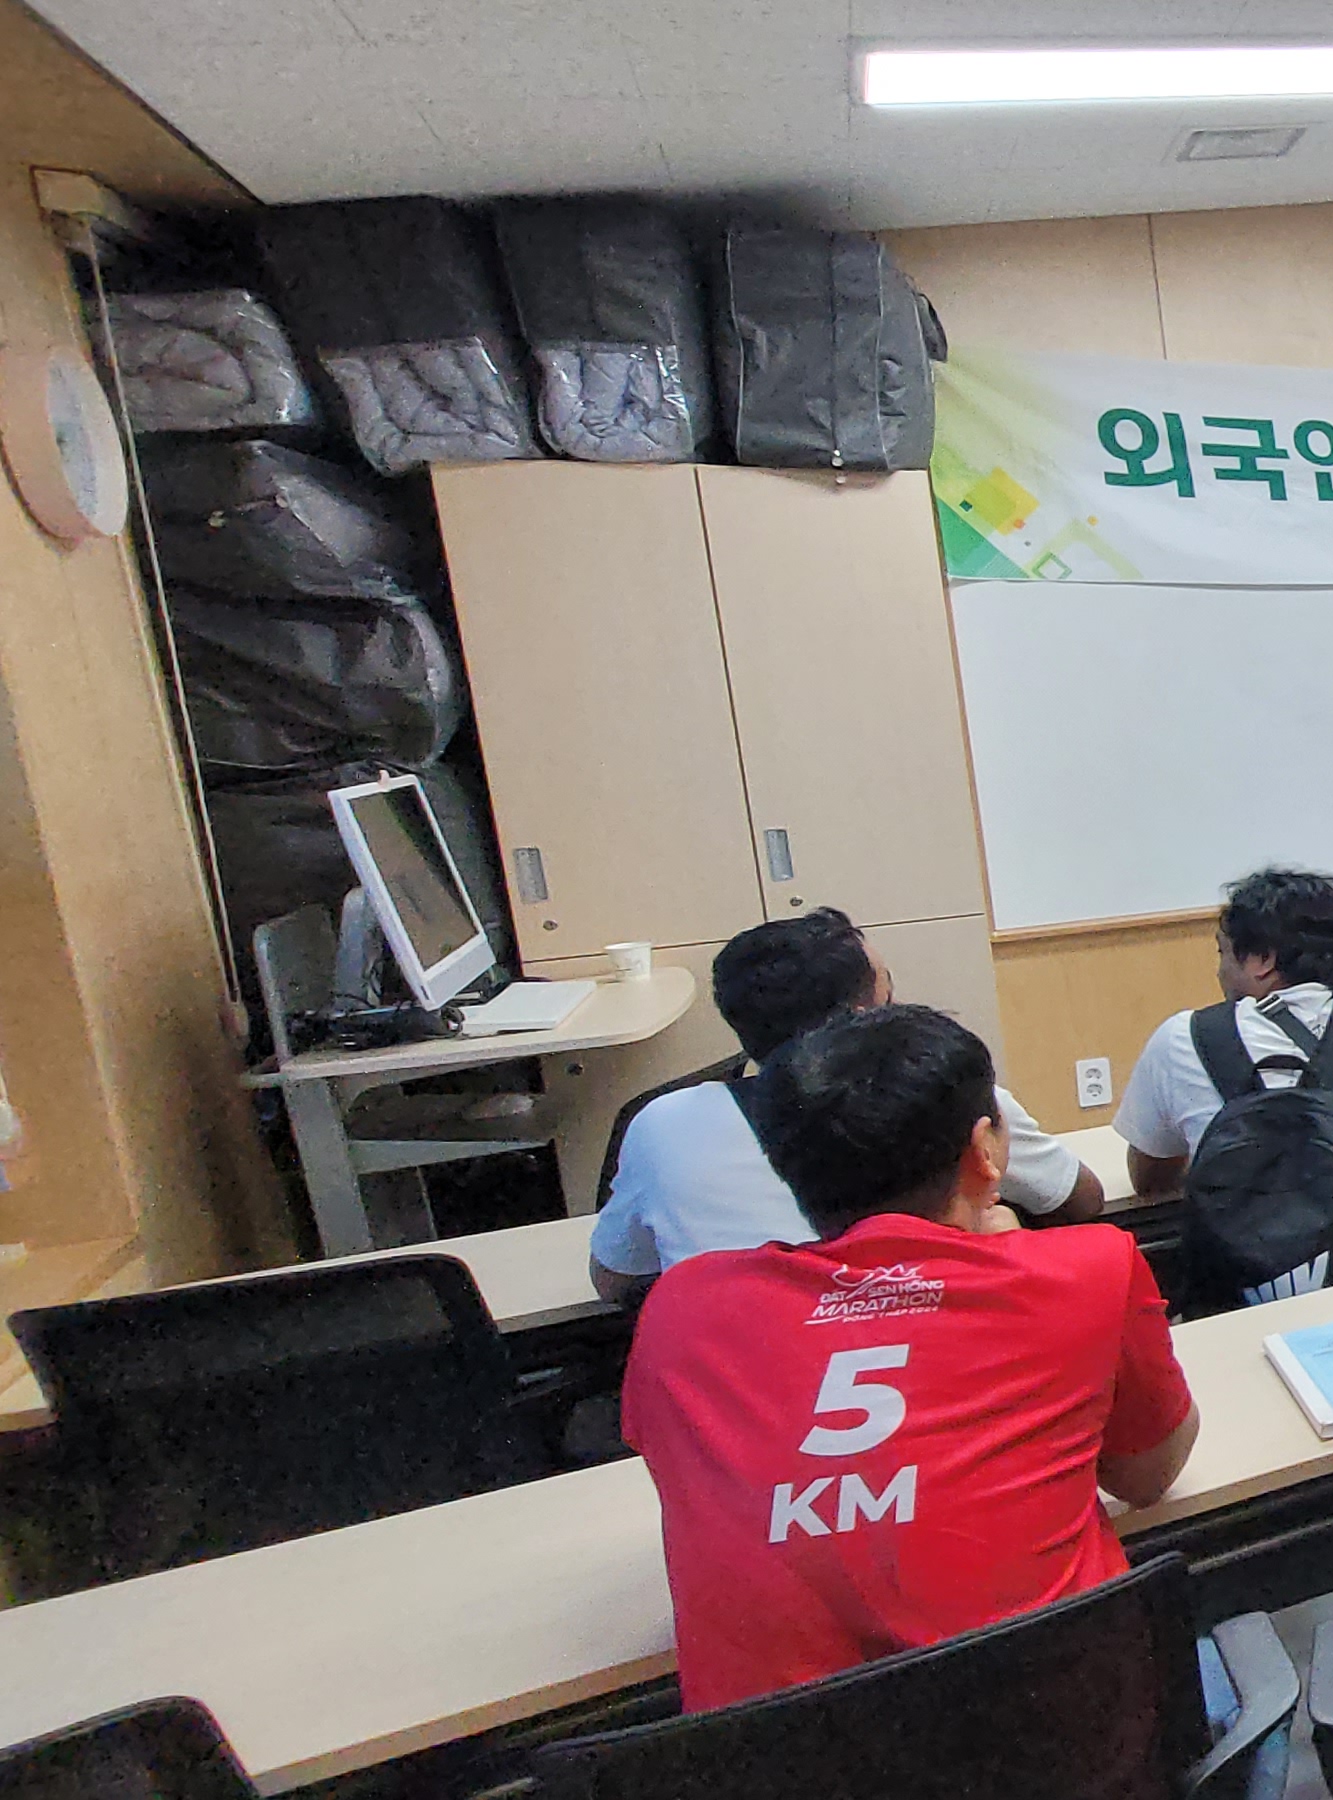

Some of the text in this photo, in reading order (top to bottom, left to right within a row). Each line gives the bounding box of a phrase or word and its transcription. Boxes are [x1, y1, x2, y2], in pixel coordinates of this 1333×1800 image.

[812, 1291, 944, 1318] MARATHON
[798, 1343, 910, 1457] 5
[768, 1464, 918, 1543] KM
